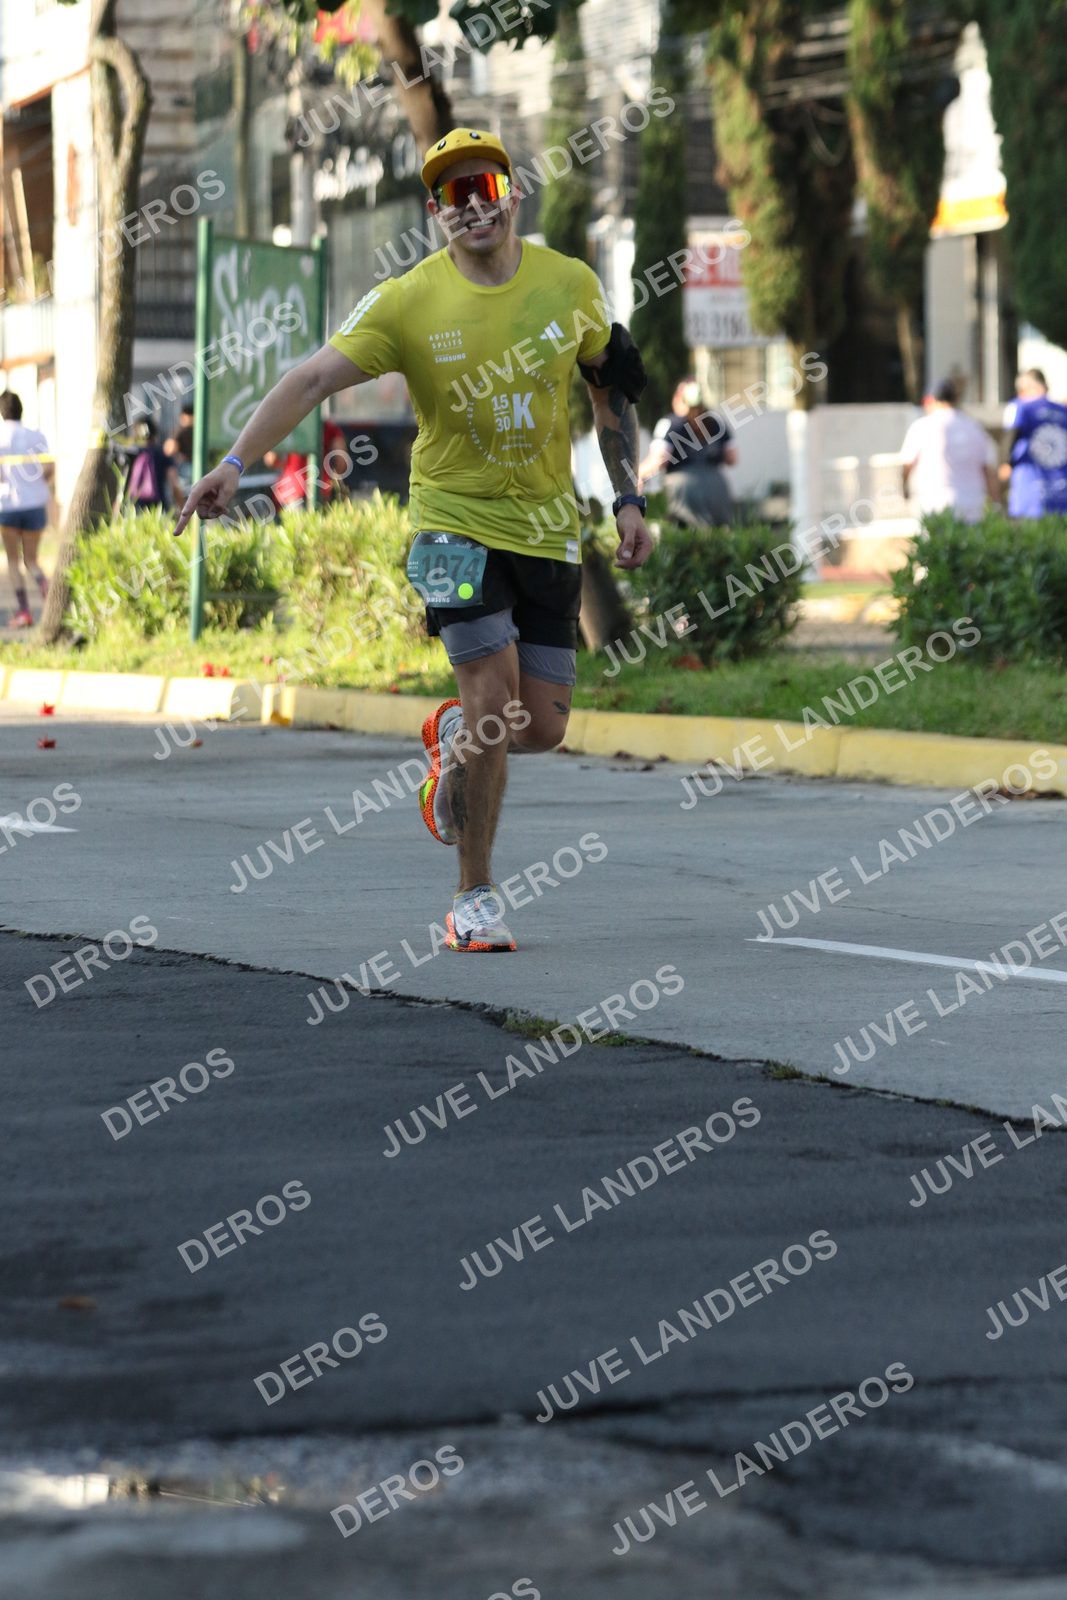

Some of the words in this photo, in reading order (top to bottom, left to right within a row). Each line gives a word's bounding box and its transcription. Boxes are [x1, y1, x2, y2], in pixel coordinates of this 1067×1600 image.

[491, 393, 509, 411] 15
[512, 391, 536, 430] K
[495, 416, 511, 433] 30
[422, 554, 480, 582] 1074
